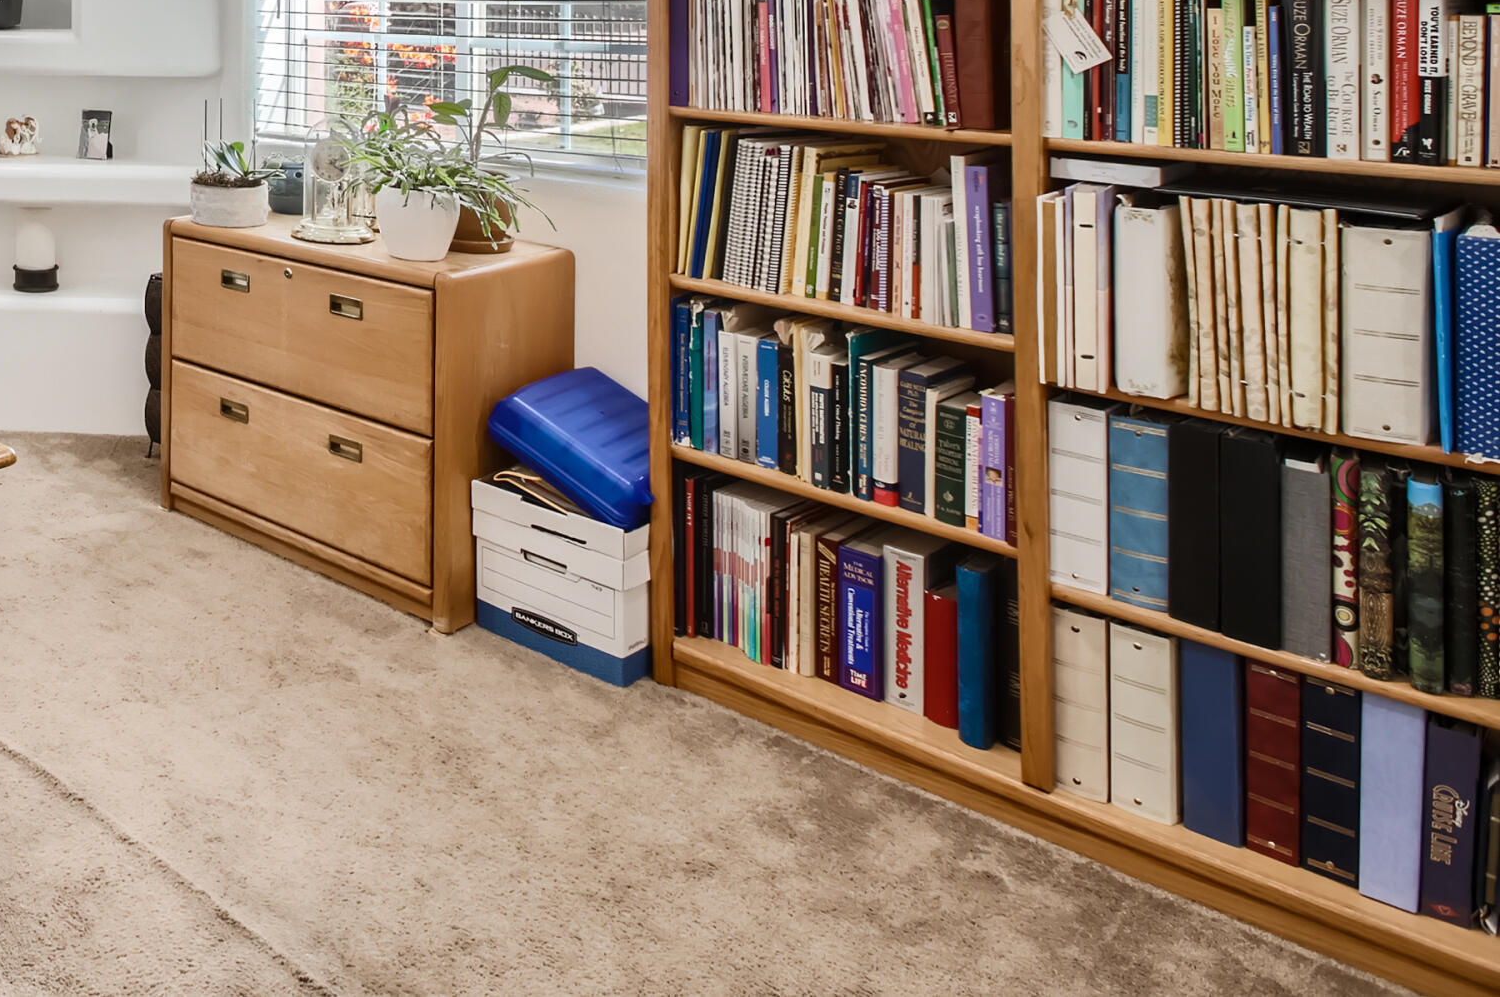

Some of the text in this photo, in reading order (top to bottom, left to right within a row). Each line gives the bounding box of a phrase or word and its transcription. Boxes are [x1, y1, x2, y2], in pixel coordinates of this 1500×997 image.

[1293, 23, 1311, 69] ORMAN
[1331, 26, 1351, 64] ORMAN
[1396, 21, 1407, 58] ORMAN
[1420, 21, 1429, 43] DON'T
[1429, 6, 1439, 75] YOU'VE EARNED IT,
[1462, 20, 1478, 66] BEYOND
[1118, 58, 1127, 71] body
[1420, 46, 1429, 64] LOSE
[1245, 67, 1253, 95] Practically
[1246, 97, 1254, 121] Anything
[1303, 71, 1313, 139] THE ROAD WEALTH
[1328, 75, 1341, 136] to BE RICH
[1341, 83, 1356, 136] COURAGE
[1424, 93, 1432, 114] ORMAN
[1460, 84, 1477, 120] GRAVE
[899, 427, 926, 439] NATURAL
[899, 440, 926, 452] HEALING
[843, 562, 875, 579] MEDICAL
[843, 571, 875, 586] ADVISOR
[819, 559, 830, 653] HEALTH SECRETS
[515, 612, 574, 642] BANKERS BOX
[847, 587, 855, 665] Conventional Treatments
[855, 607, 864, 643] Alternative
[896, 560, 913, 689] Alternative Medicine
[849, 668, 867, 680] TIME
[850, 677, 869, 688] LIFE
[1430, 785, 1460, 866] CRUISE LINE
[1452, 799, 1470, 828] Disney
